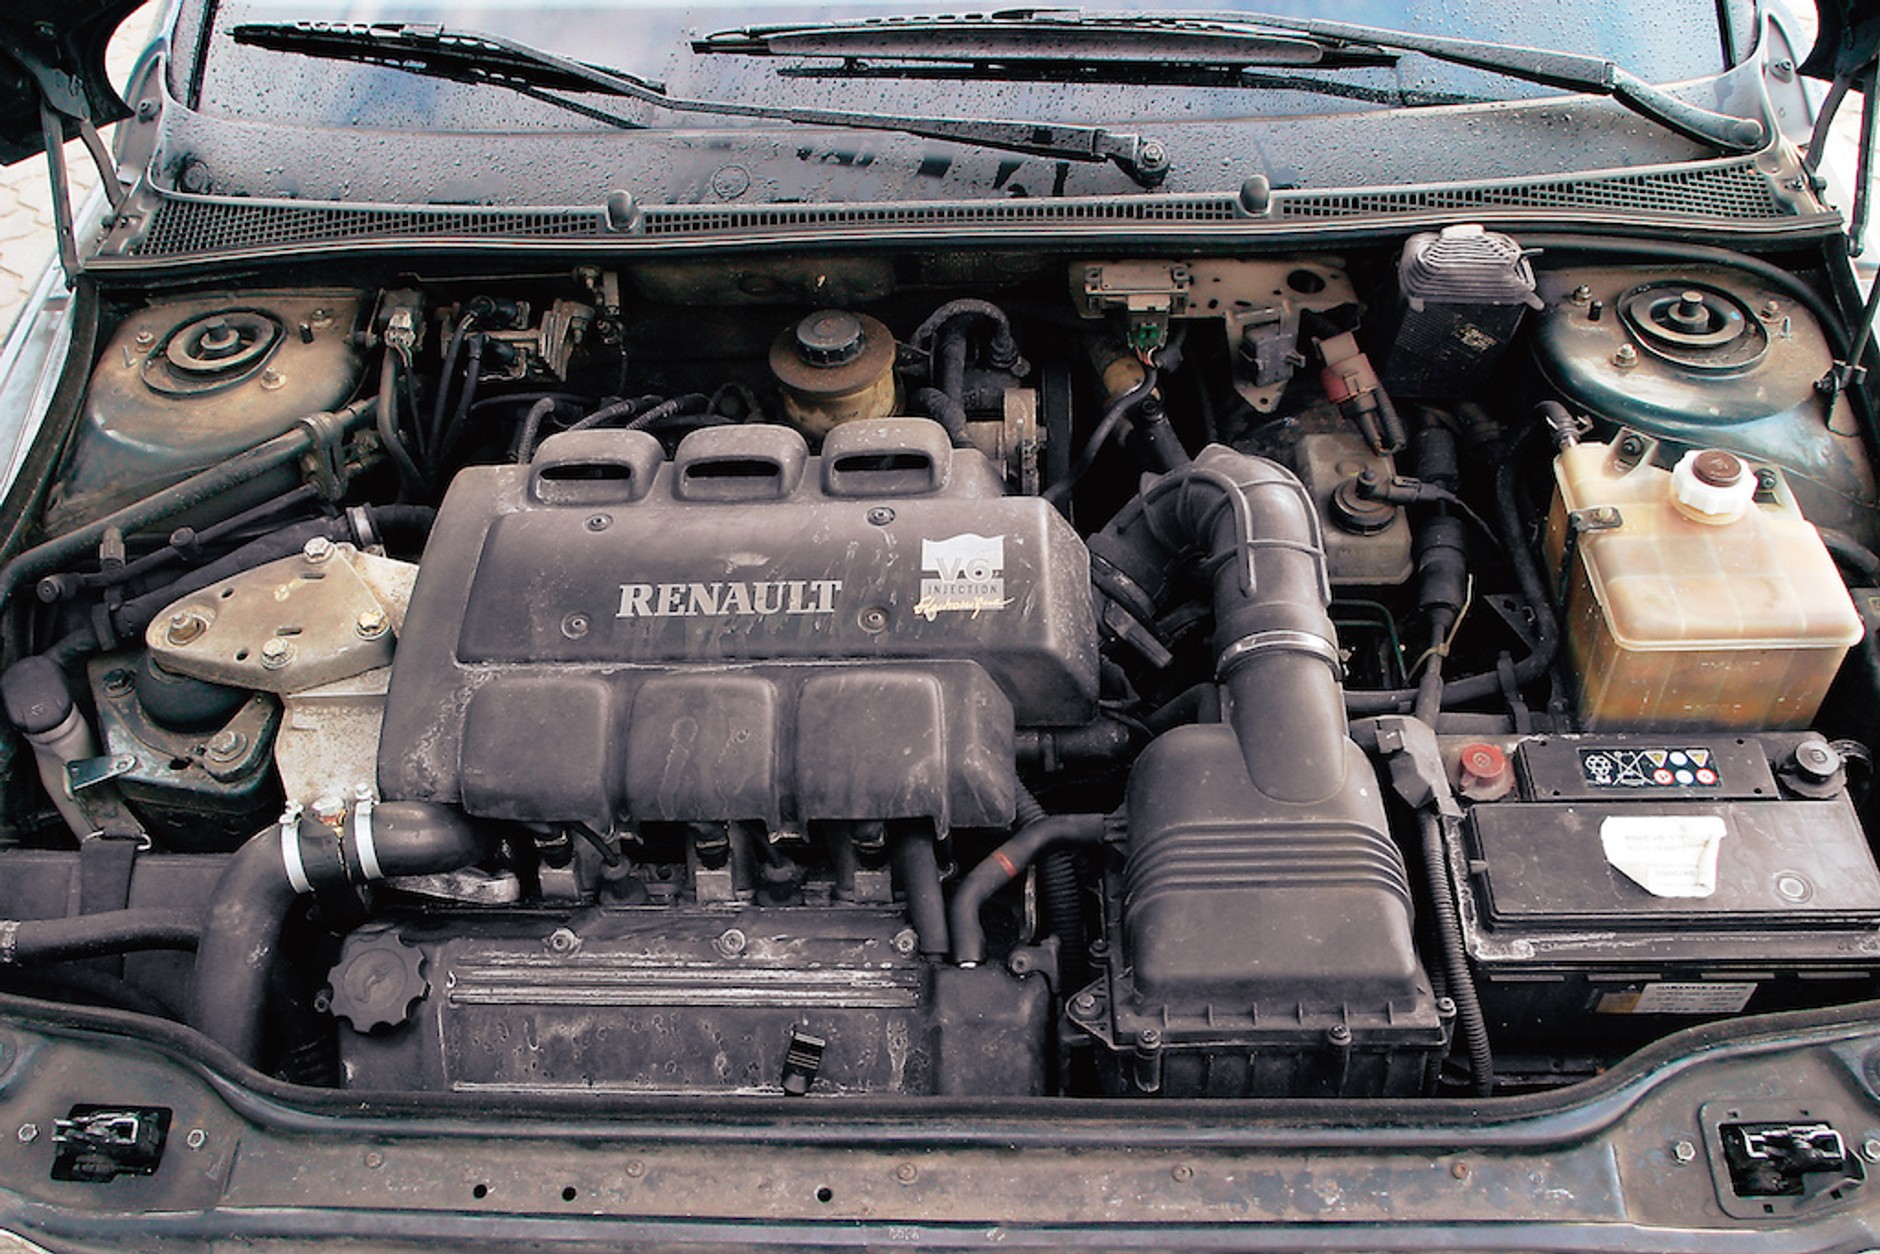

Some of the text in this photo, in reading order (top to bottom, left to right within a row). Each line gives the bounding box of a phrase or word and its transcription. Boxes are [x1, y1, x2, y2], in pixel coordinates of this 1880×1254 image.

[936, 557, 992, 583] V6
[615, 580, 842, 618] RENAULT
[928, 585, 997, 594] INJECTION
